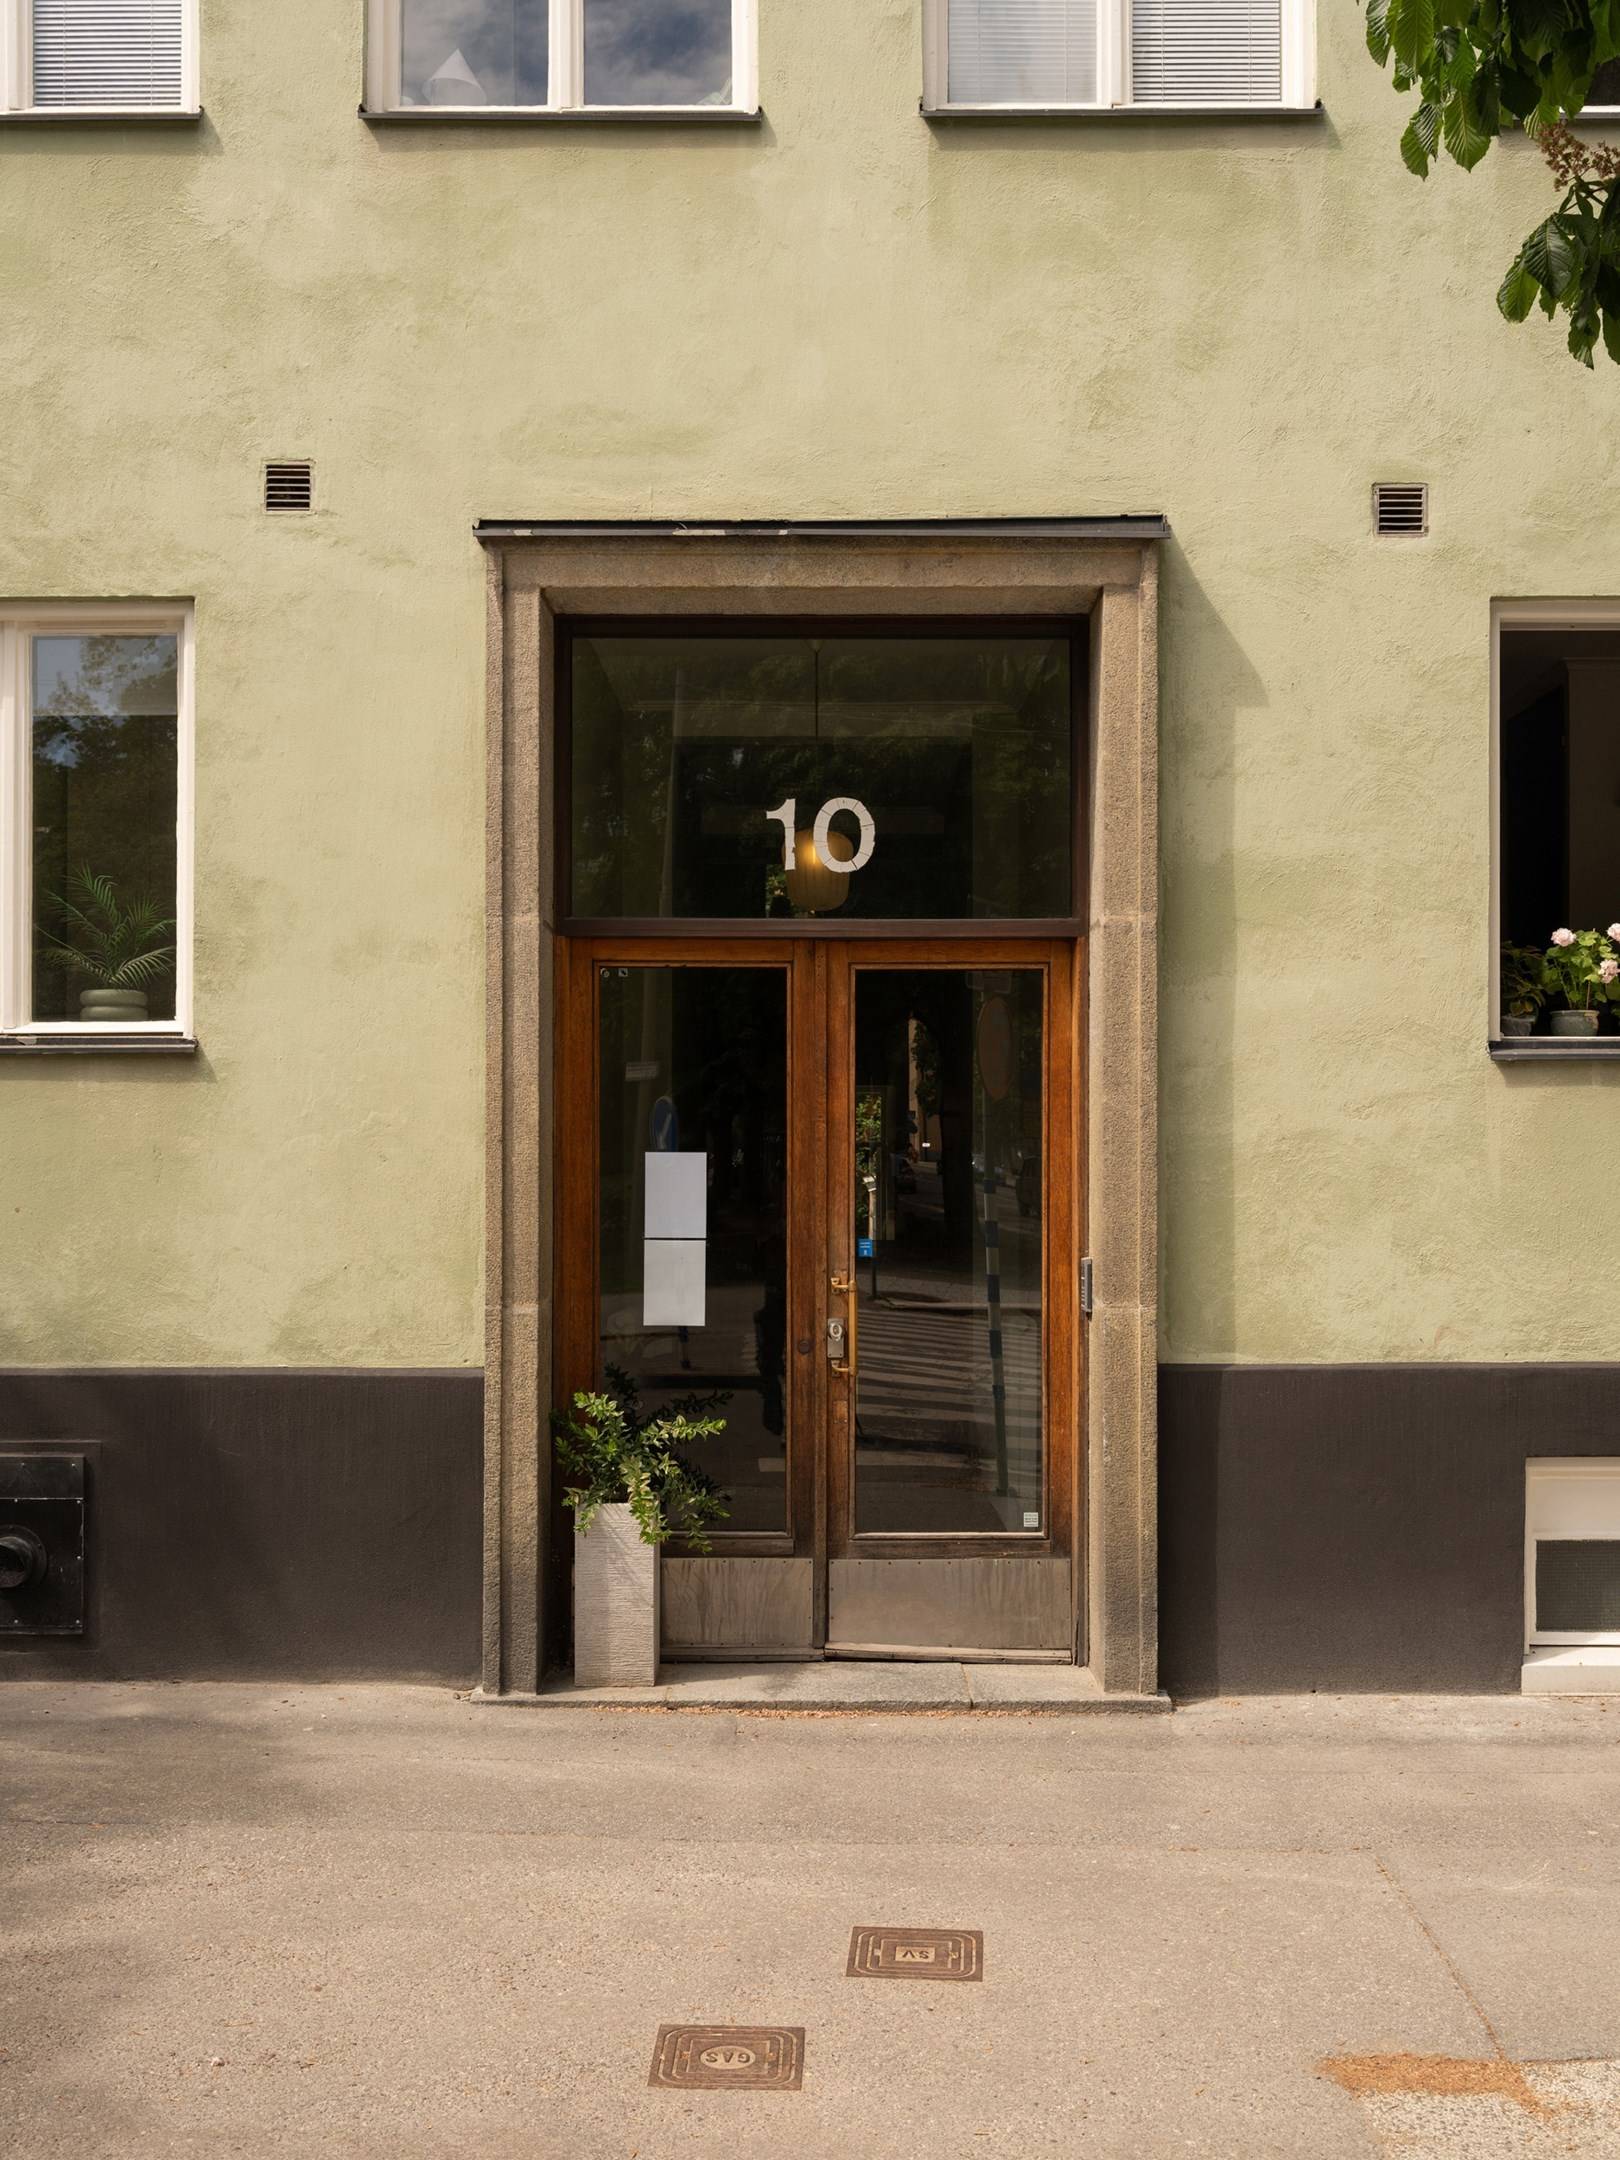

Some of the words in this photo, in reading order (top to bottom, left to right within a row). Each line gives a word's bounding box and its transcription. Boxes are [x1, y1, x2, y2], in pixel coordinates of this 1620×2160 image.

[766, 797, 876, 873] 10
[902, 1950, 929, 1959] SV
[705, 2052, 751, 2063] GAS
